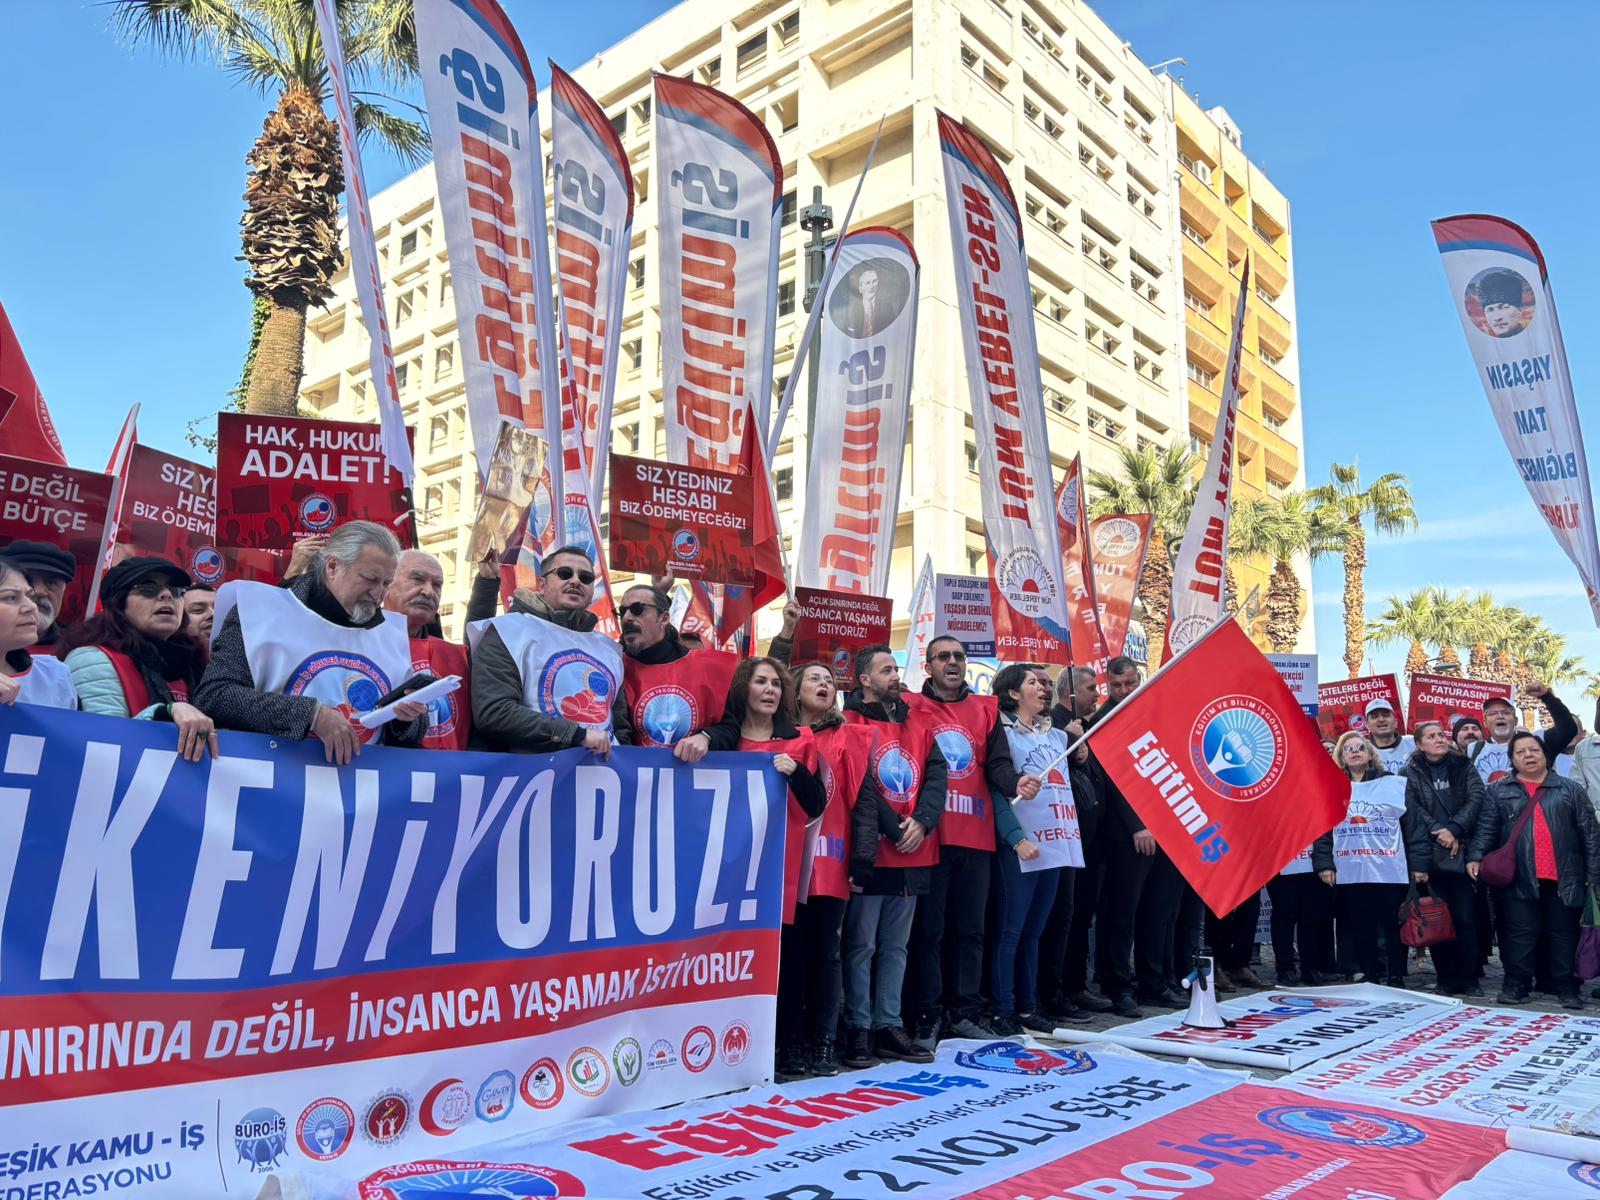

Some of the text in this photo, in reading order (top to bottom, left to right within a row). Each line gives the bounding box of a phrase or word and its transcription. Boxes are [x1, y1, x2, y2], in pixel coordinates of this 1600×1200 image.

[245, 424, 305, 451] HAK,
[240, 448, 391, 484] ADALET!
[10, 472, 86, 503] DEĞİL
[653, 486, 717, 511] HESABI
[3, 498, 89, 533] BÜTÇE
[642, 500, 746, 530] ÖDEMEYECEĞİZ!
[808, 595, 829, 607] AÇLIK
[829, 597, 862, 610] SINIRINDA
[844, 610, 887, 627] YAŞAMAK
[1360, 678, 1388, 691] DEĞİL
[1361, 689, 1392, 701] BÜTÇE
[1431, 685, 1490, 700] FATURASINI
[1195, 699, 1283, 797] EĞİTİM VE BİLİM İŞGÖRENLERİ SENDİKASI
[204, 998, 335, 1060] DEĞİL,
[346, 986, 501, 1043] İNSANCA
[510, 967, 640, 1022] YAŞAMAK
[639, 949, 755, 996] İSTİYORUZ
[1284, 1037, 1313, 1050] 5
[1296, 1016, 1378, 1047] NOLU
[235, 1115, 286, 1138] BÜRO-İŞ
[66, 1131, 154, 1167] KAMU
[180, 1120, 205, 1152] İŞ
[843, 1169, 931, 1192] 2
[890, 1112, 1082, 1176] NOLU
[257, 1165, 274, 1174] 2006
[641, 1167, 761, 1200] Eğitim
[764, 1159, 800, 1175] ve
[786, 1137, 871, 1164] Bilim
